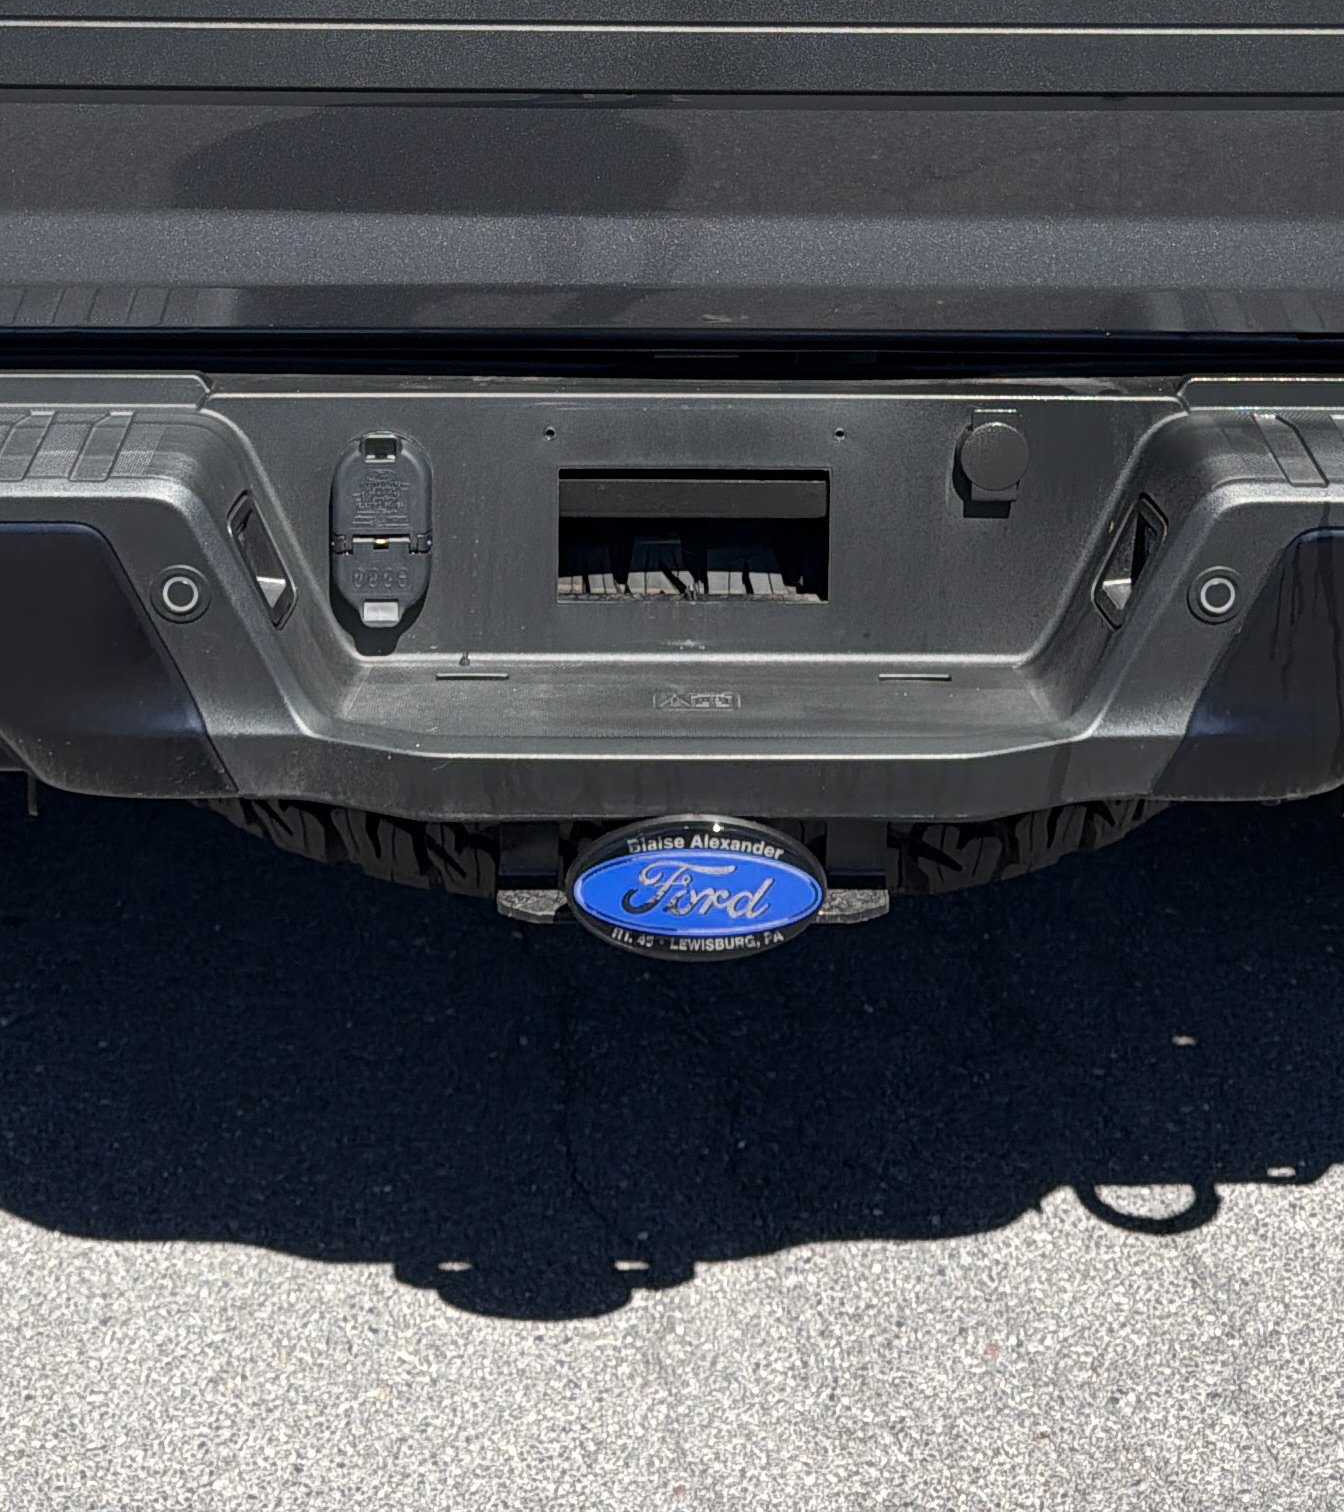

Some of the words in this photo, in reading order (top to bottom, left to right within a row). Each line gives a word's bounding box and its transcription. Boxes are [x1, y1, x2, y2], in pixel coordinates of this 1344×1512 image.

[627, 837, 684, 853] Blaise
[690, 834, 784, 859] Alexander
[622, 861, 773, 920] Ford
[670, 935, 761, 951] LEWISBURG,
[764, 931, 784, 945] PA
